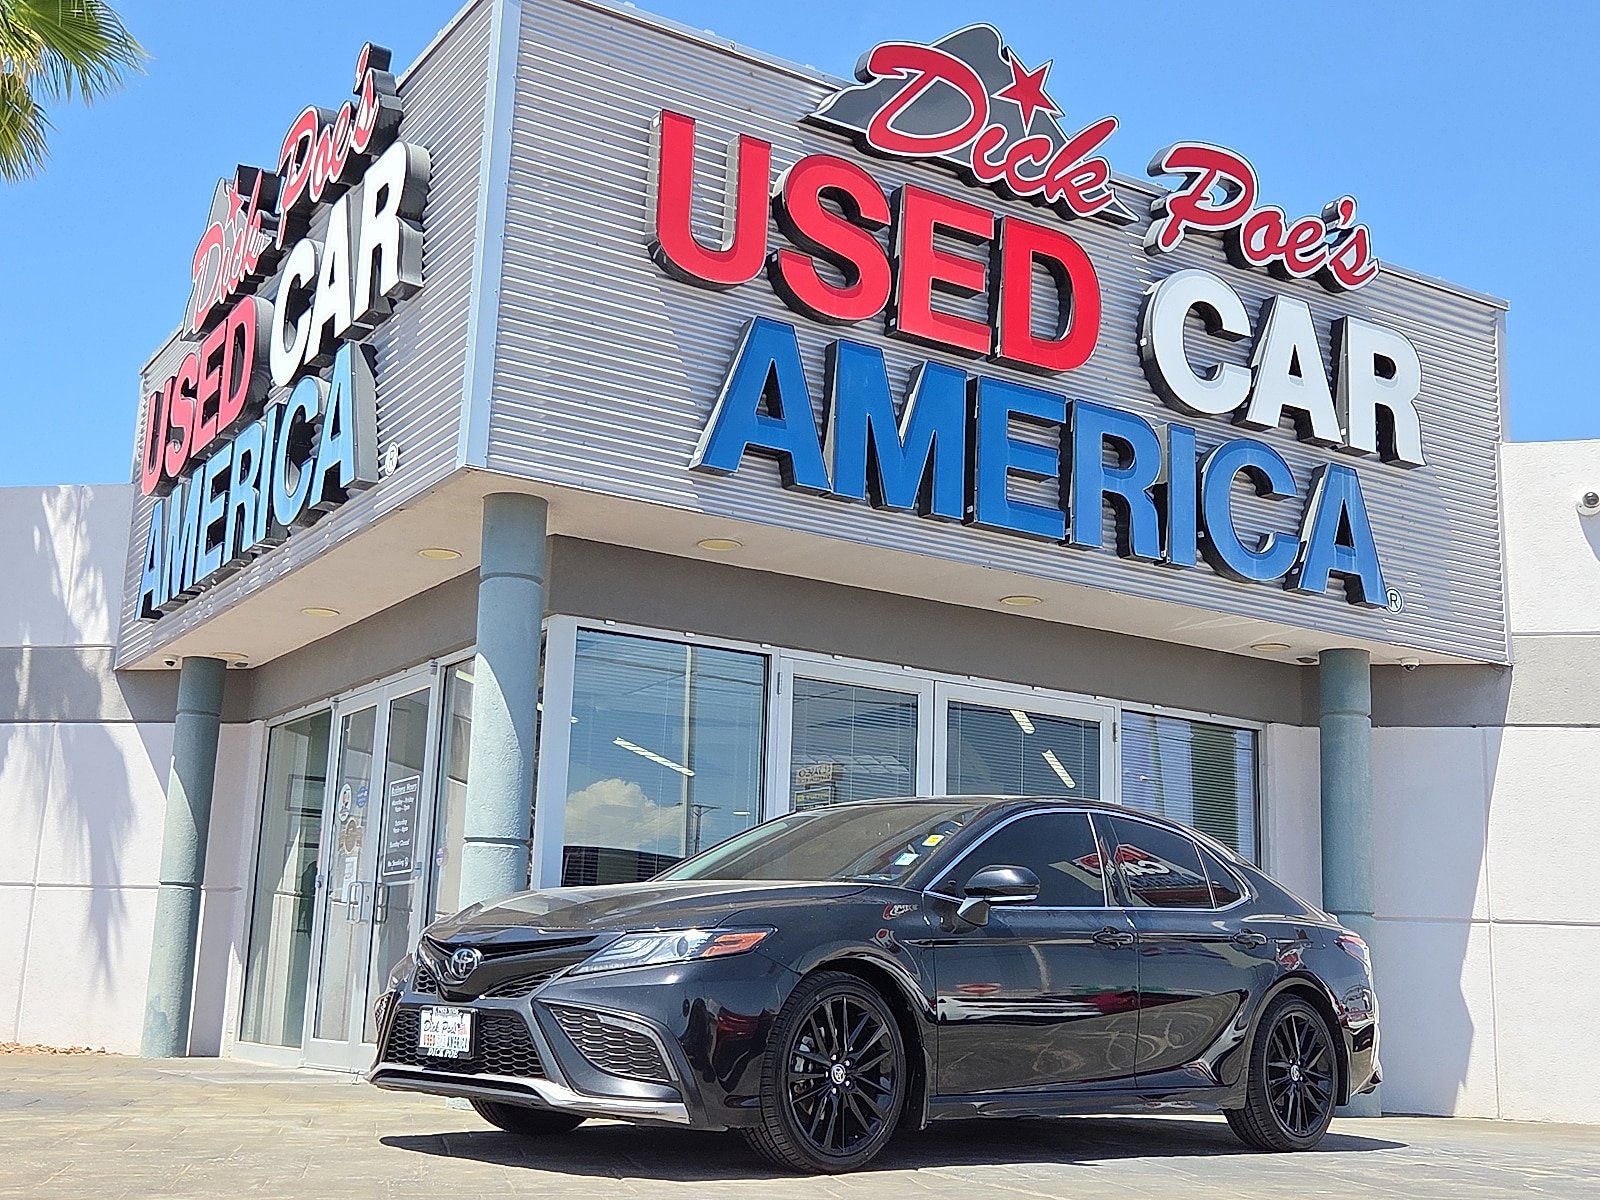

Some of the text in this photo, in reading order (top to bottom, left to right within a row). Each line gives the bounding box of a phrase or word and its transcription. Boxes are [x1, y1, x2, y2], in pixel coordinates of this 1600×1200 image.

[192, 42, 379, 333] Dick Poe's
[651, 110, 1427, 466] USED CAR
[858, 41, 1380, 290] Dick Poe's
[141, 141, 407, 496] USED CAR
[695, 316, 1387, 606] AMERICA
[135, 341, 356, 620] AMERICA
